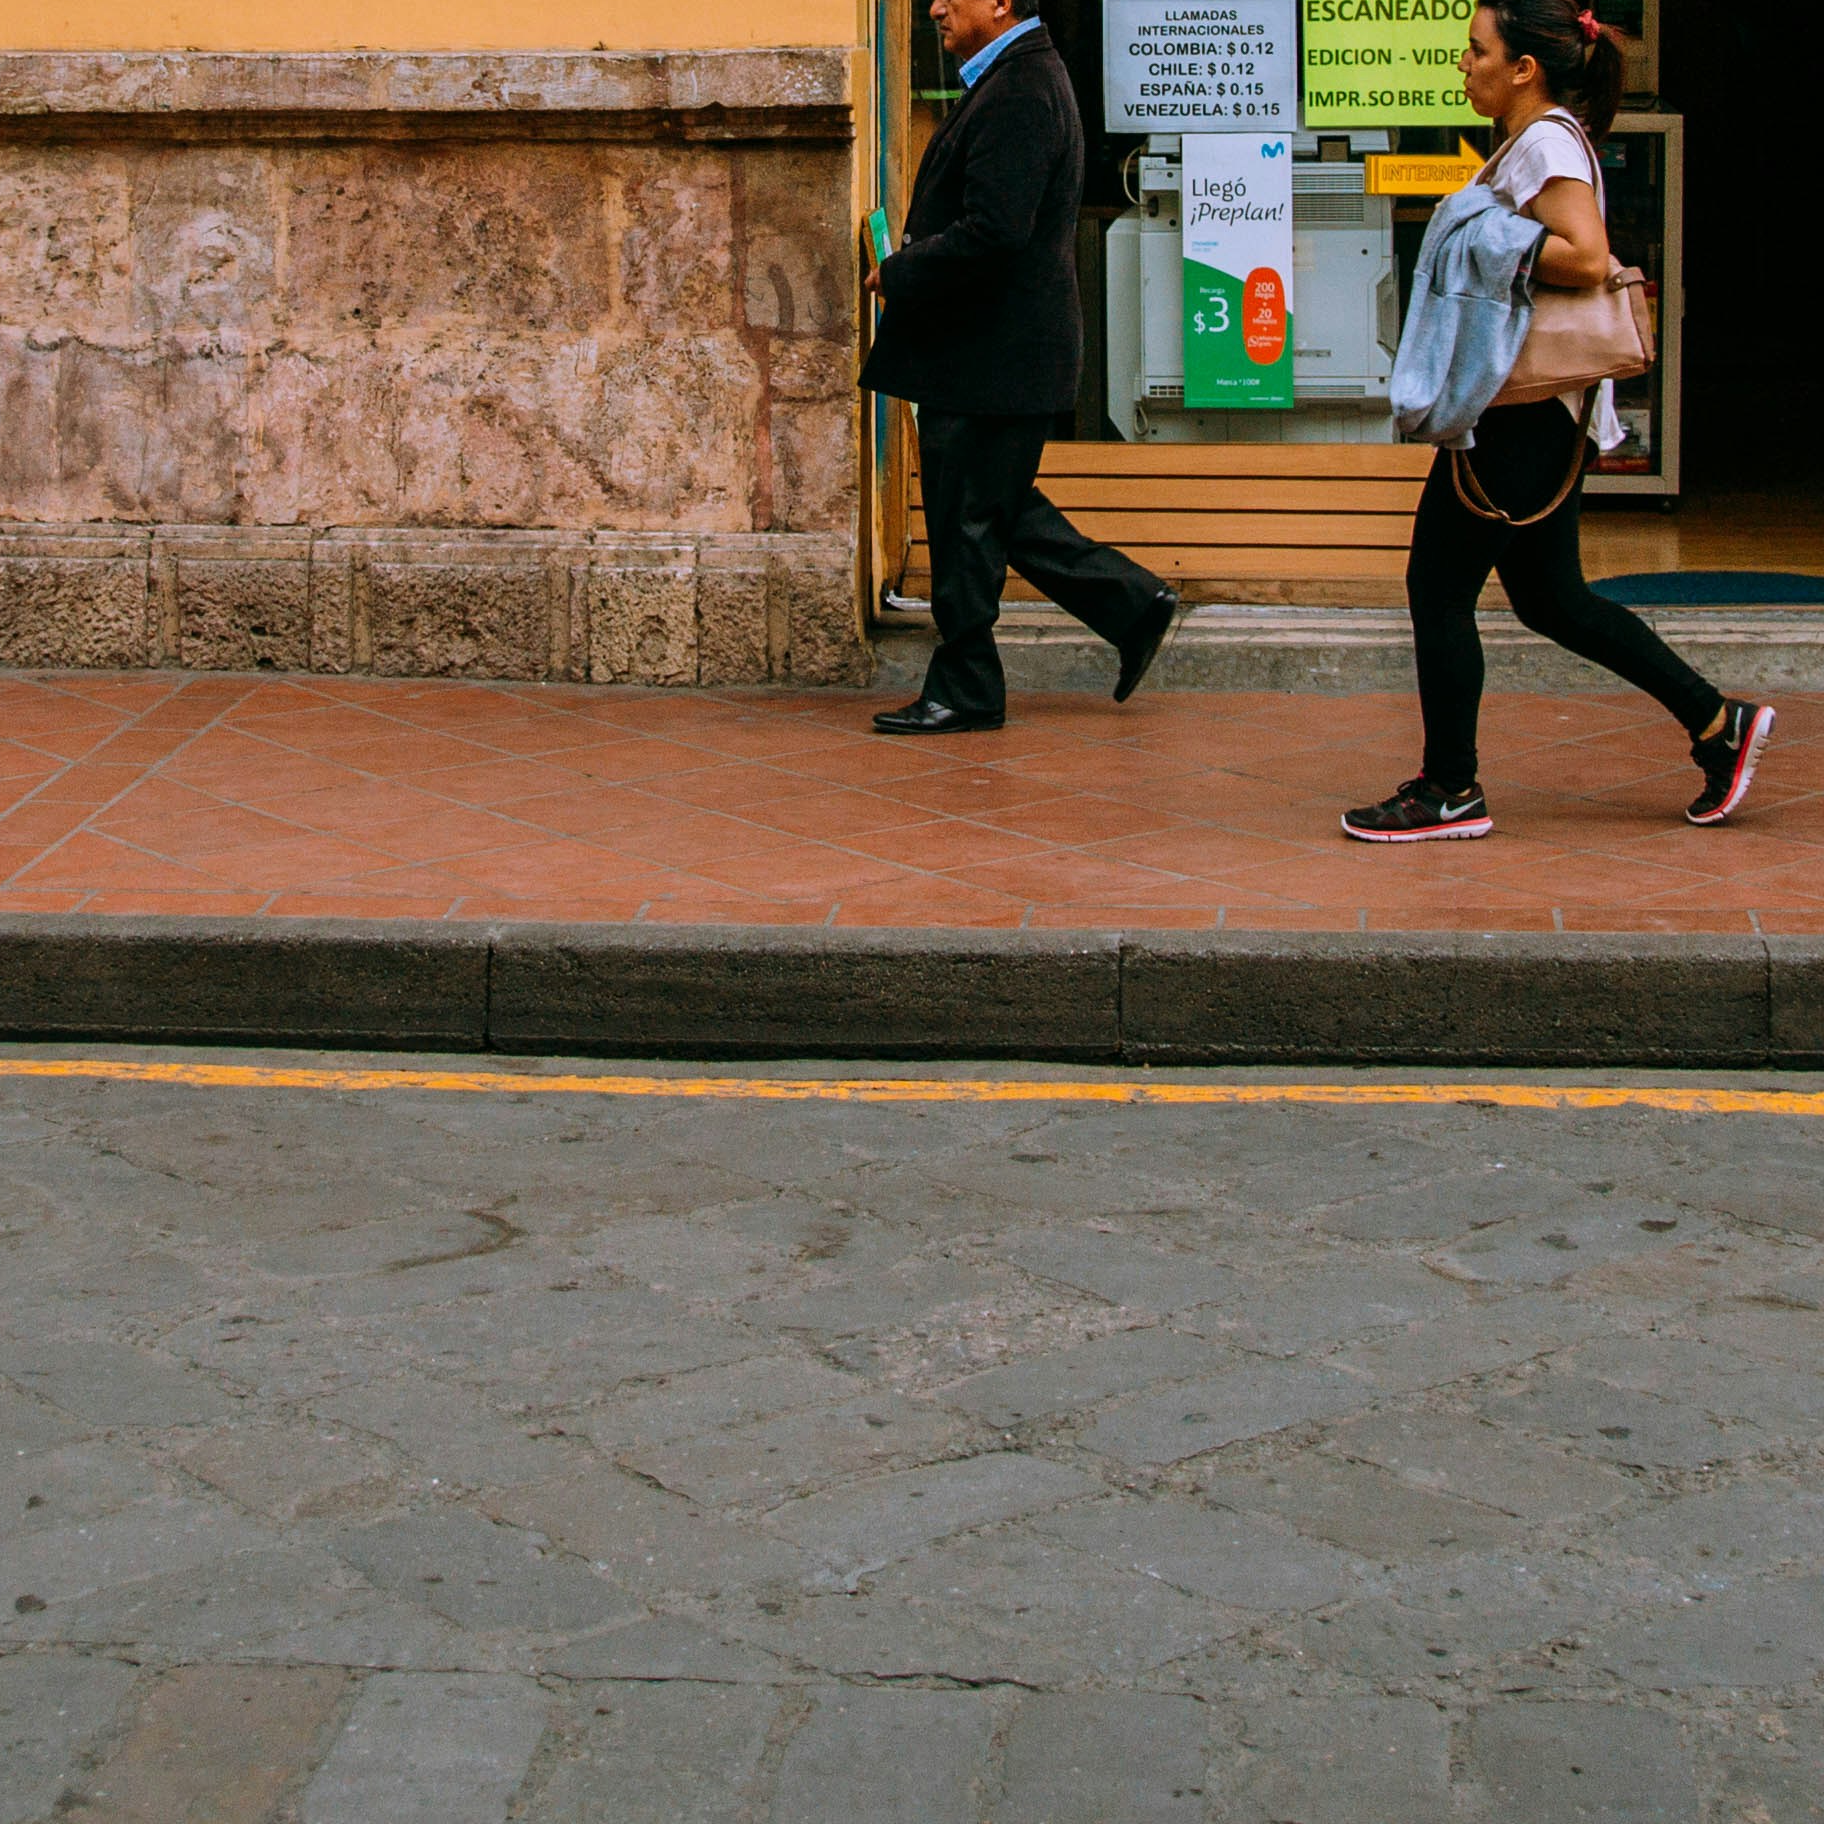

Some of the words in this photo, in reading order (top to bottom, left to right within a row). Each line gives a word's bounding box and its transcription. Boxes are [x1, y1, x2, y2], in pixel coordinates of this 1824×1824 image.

[1165, 10, 1238, 22] LLAMADAS
[1307, 0, 1478, 21] ESCANEADO
[1138, 25, 1264, 36] INTERNACIONALES
[1129, 43, 1222, 56] COLOMBIA:
[1227, 42, 1236, 57] $
[1240, 42, 1274, 55] 0.12
[1307, 48, 1392, 65] EDICION
[1149, 63, 1203, 76] CHILE:
[1207, 62, 1216, 78] $
[1221, 63, 1254, 76] 0.12
[1140, 80, 1212, 97] ESPAÑA:
[1217, 83, 1225, 98] $
[1230, 83, 1264, 96] 0.15
[1124, 104, 1228, 117] VENEZUELA:
[1233, 103, 1241, 118] $
[1246, 103, 1280, 116] 0.15
[1382, 164, 1476, 182] INTERNET
[1192, 177, 1246, 202] Llegó
[1190, 201, 1284, 226] ¡Preplan!
[1255, 282, 1275, 292] 200
[1259, 308, 1272, 319] 20
